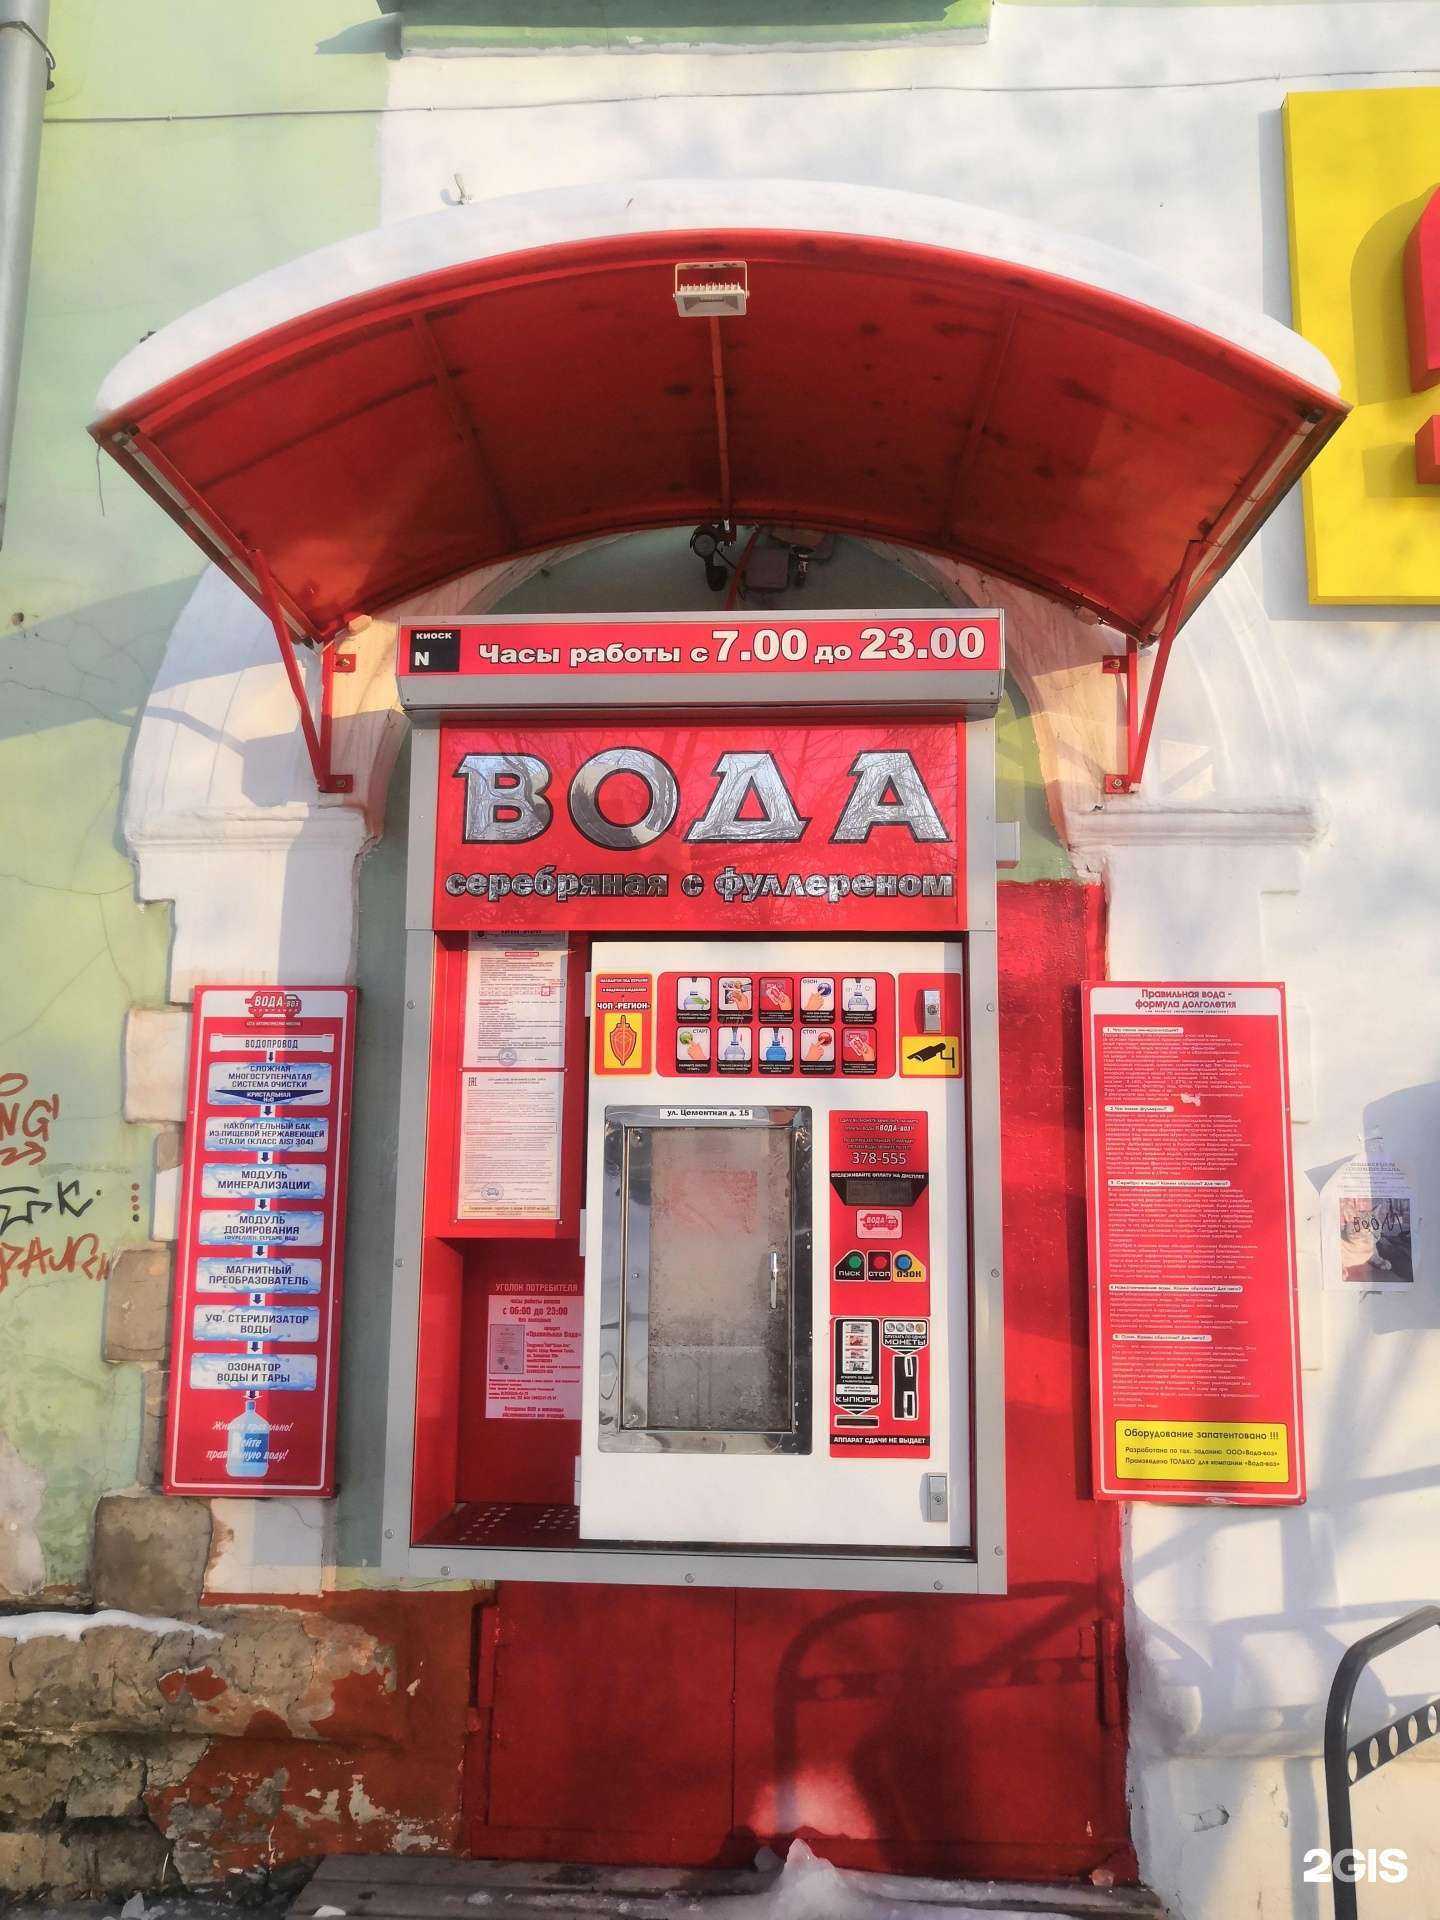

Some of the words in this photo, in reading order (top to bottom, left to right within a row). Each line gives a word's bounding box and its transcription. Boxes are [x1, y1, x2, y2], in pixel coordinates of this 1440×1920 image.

[479, 644, 560, 664] Часы
[570, 643, 681, 668] работы
[690, 645, 709, 664] с
[711, 630, 809, 663] 7.00
[814, 642, 853, 666] до
[858, 626, 986, 662] 23.00
[414, 651, 430, 666] N
[452, 747, 953, 851] ВОДА
[446, 865, 669, 903] серебряная
[681, 872, 704, 897] с
[714, 866, 954, 904] фуллереном
[1142, 989, 1200, 999] Правильная
[1202, 990, 1226, 999] вода
[1136, 999, 1180, 1010] формула
[1182, 1000, 1237, 1010] долголетия
[245, 1040, 299, 1049] ВОДОПРОВОД
[680, 1109, 728, 1117] Цементная
[224, 1122, 294, 1130] НАКОПИТЕЛЬНЫЙ
[222, 1130, 260, 1138] ПИЩЕВОЙ
[262, 1130, 325, 1138] НЕРЖАВЕЮЩЕЙ
[852, 1153, 907, 1165] 378-555
[241, 1170, 288, 1180] МОДУЛЬ
[218, 1181, 311, 1191] МИНЕРАЛИЗАЦИИ
[239, 1215, 286, 1225] МОДУЛЬ
[224, 1226, 300, 1235] ДОЗИРОВАНИЯ
[226, 1265, 292, 1275] МАГНИТНЫЙ
[896, 1270, 922, 1278] ОЗОН
[208, 1276, 309, 1286] ПРЕОБРАЗОВАТЕЛЬ
[526, 1284, 578, 1292] ПОТРЕБИТЕЛЯ
[228, 1315, 309, 1324] СТЕРИЛИЗАТОР
[240, 1325, 272, 1335] ВОДЫ
[227, 1363, 281, 1372] ОЗОНАТОР
[217, 1373, 248, 1383] ВОДЫ
[251, 1374, 259, 1383] И
[262, 1374, 291, 1383] ТАРЫ
[1124, 1429, 1193, 1440] Оборудование
[1196, 1431, 1267, 1440] запатентовано
